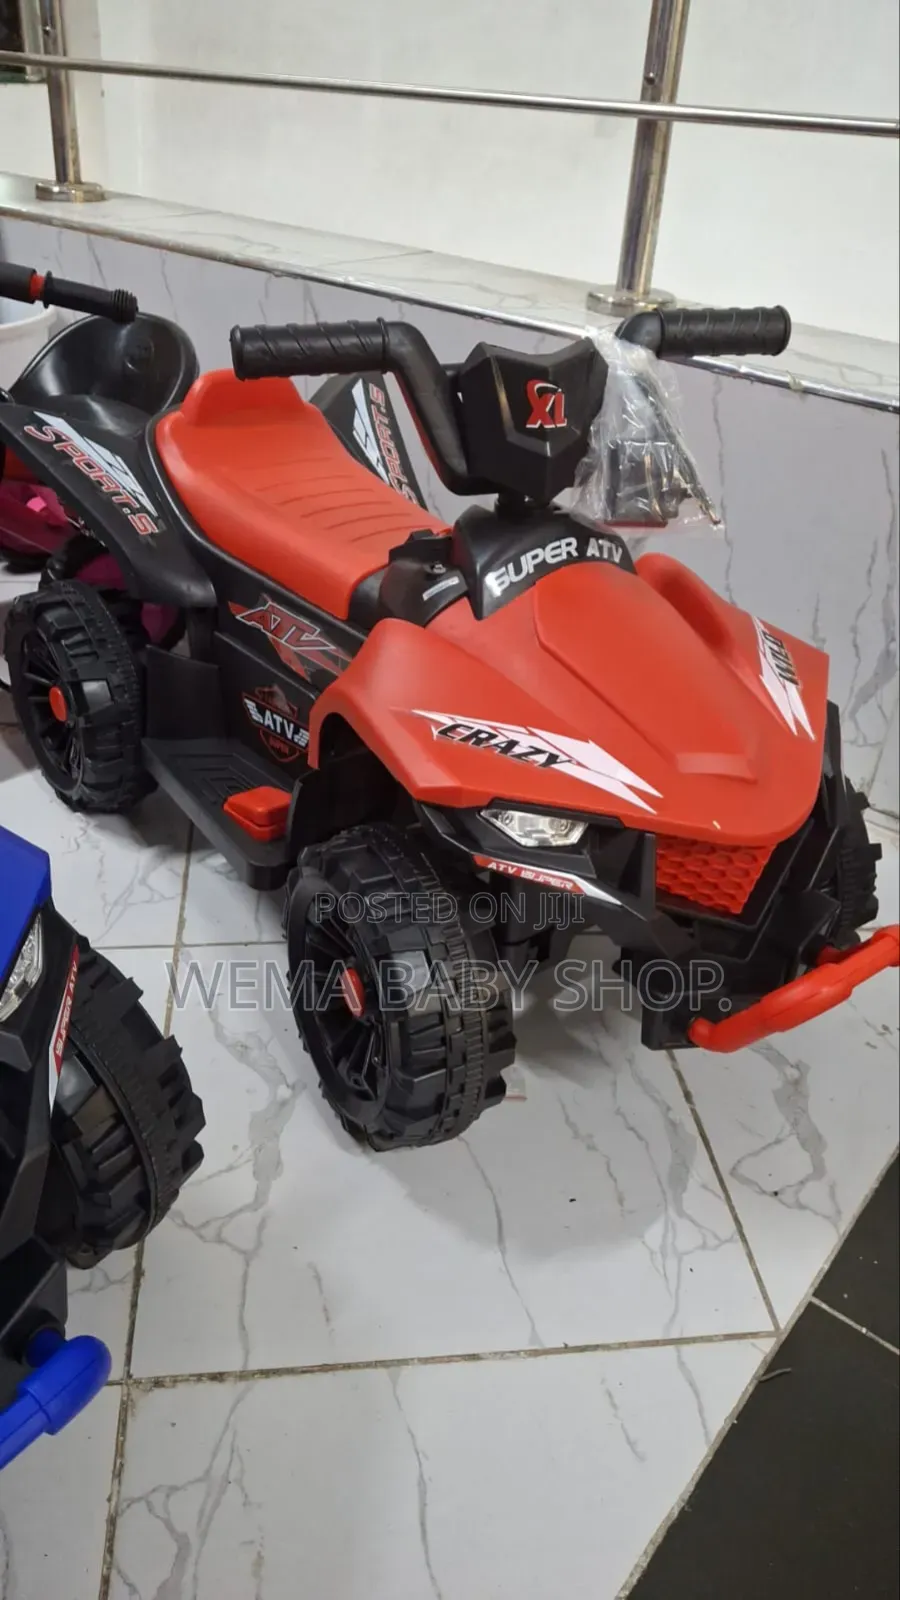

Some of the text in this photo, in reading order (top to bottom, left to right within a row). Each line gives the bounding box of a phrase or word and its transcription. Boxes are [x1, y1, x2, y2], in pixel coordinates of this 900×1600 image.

[23, 425, 159, 536] SPORT.S
[484, 536, 623, 598] SUPER ATV
[235, 601, 337, 650] ATV
[761, 629, 800, 686] WILD
[263, 709, 295, 740] ATV
[436, 722, 573, 769] CRAZY
[487, 861, 574, 890] ATV SUPER
[55, 960, 78, 1057] SUPER ATV
